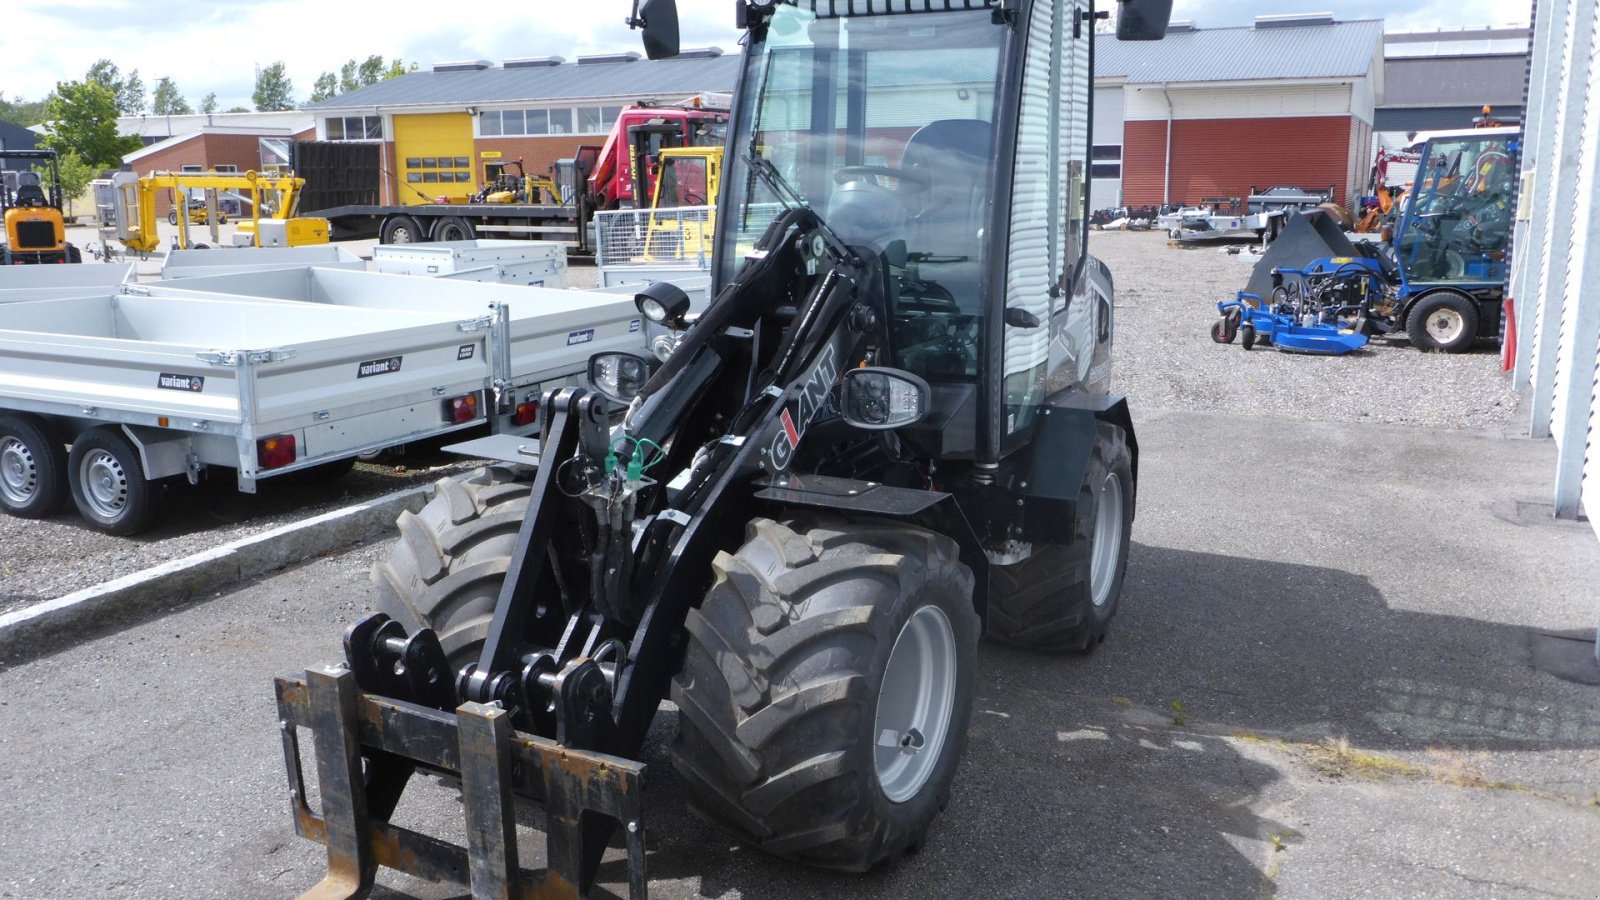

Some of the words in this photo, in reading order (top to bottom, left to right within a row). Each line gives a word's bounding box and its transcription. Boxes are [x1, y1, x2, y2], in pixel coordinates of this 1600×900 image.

[360, 359, 390, 376] variant
[160, 376, 190, 389] variant
[771, 343, 836, 471] GIANT
